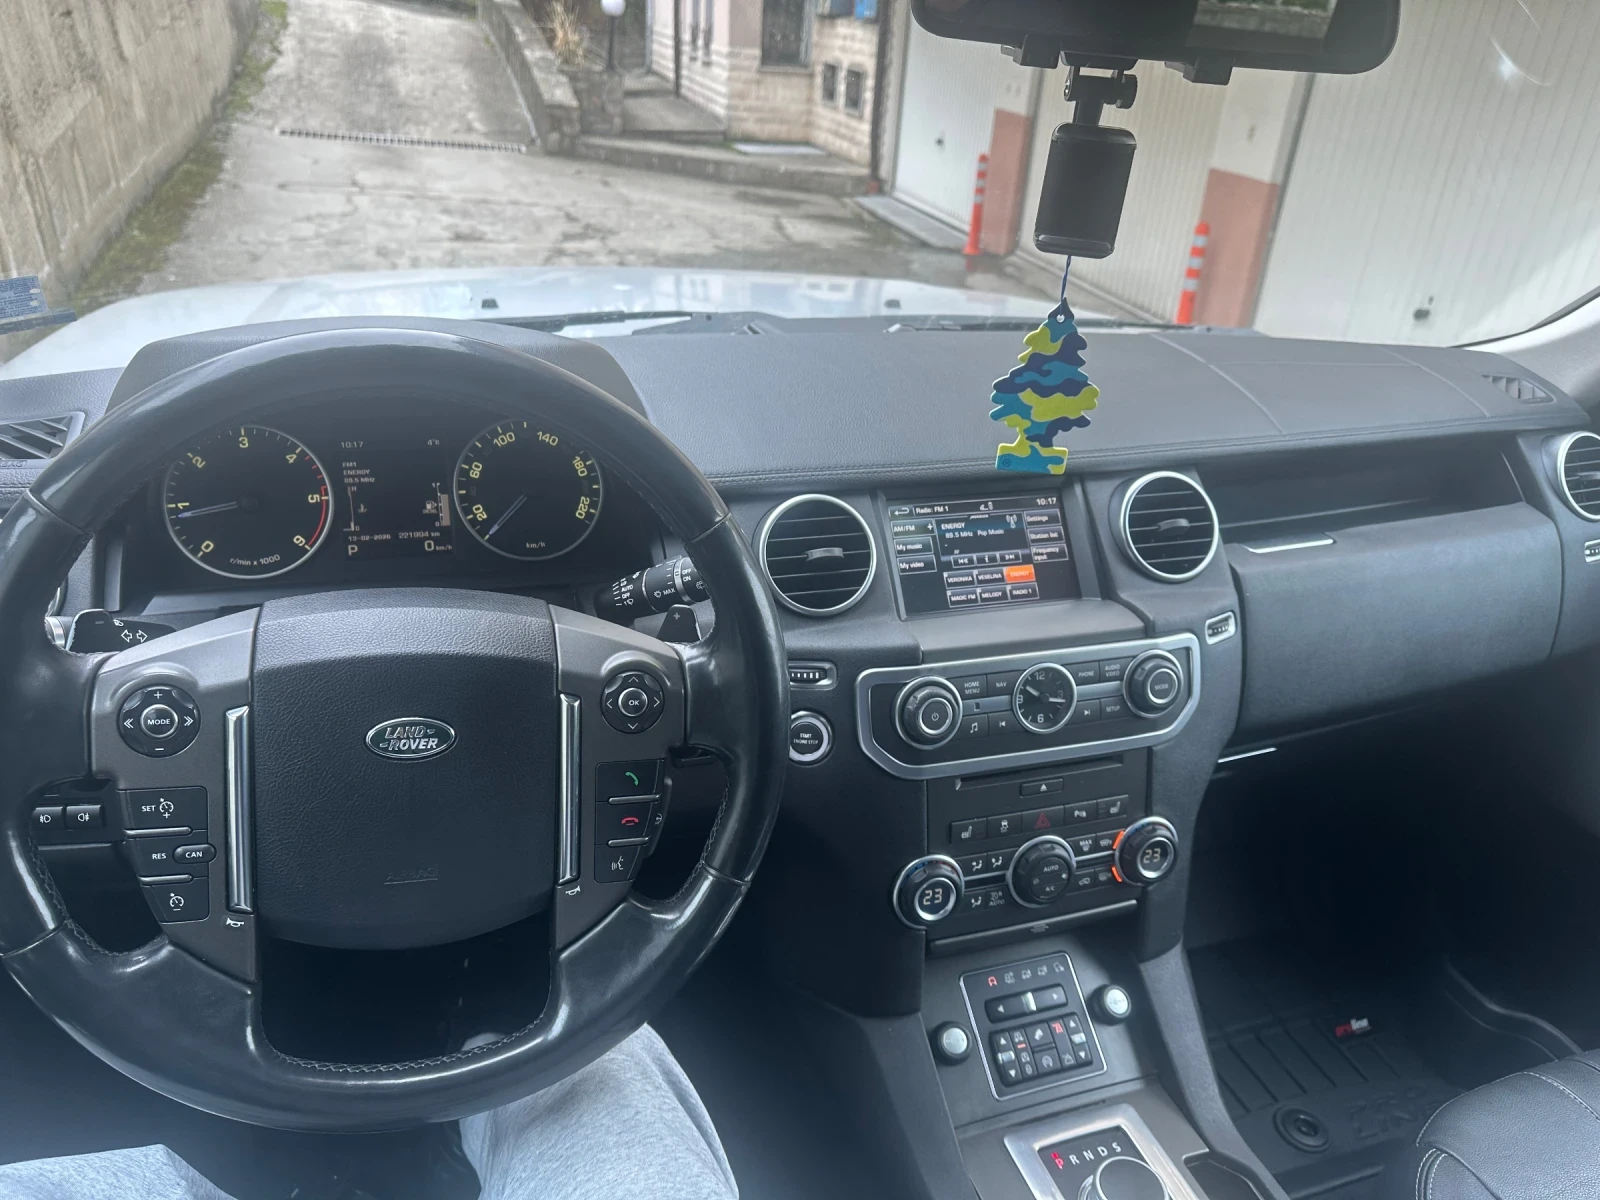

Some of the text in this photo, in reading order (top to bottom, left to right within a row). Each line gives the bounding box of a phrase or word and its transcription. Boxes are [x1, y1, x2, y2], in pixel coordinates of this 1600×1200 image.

[238, 437, 249, 448] 3
[493, 431, 516, 447] 100
[536, 431, 559, 446] 140
[340, 441, 364, 449] 10:17
[191, 455, 206, 469] 2
[285, 453, 297, 465] 4
[469, 461, 483, 479] 60
[572, 456, 588, 477] 180
[307, 493, 320, 504] 5
[1036, 497, 1057, 506] 10:17
[472, 504, 488, 521] 20
[575, 496, 590, 520] 220
[1026, 515, 1049, 523] Settings
[893, 524, 916, 533] AM/FM
[940, 522, 966, 530] ENERGY
[945, 531, 960, 539] 89.5
[977, 529, 988, 537] Pop
[1029, 532, 1049, 540] Station
[293, 535, 306, 547] 6
[525, 541, 546, 549] km/h
[201, 540, 215, 553] 0
[347, 544, 358, 556] P
[424, 540, 435, 552] 0
[896, 544, 906, 552] My
[1032, 546, 1060, 555] Frequency
[229, 557, 251, 566] r/min
[259, 554, 281, 565] 1000
[899, 560, 925, 570] My video
[947, 575, 973, 583] VERONIKA
[977, 573, 1002, 581] VESELINA
[621, 584, 634, 592] AUTO
[981, 591, 1003, 599] MELODY
[1104, 663, 1121, 671] AUDIO
[1034, 671, 1045, 681] 12
[1078, 670, 1095, 678] PHONE
[1105, 670, 1120, 678] VIDEO
[964, 680, 980, 688] HOME
[1154, 682, 1169, 691] MODE
[964, 687, 981, 695] MENU
[1105, 705, 1121, 713] SETUP
[147, 718, 171, 726] MODE
[1037, 713, 1045, 723] 6
[384, 725, 427, 739] LAND
[388, 737, 439, 751] ROVER
[141, 804, 156, 812] SET
[152, 852, 167, 860] RES
[185, 851, 203, 859] CAN
[1143, 848, 1162, 864] 23
[1043, 864, 1059, 872] AUTO
[923, 888, 943, 906] 23
[1054, 1141, 1122, 1170] P R N D S
